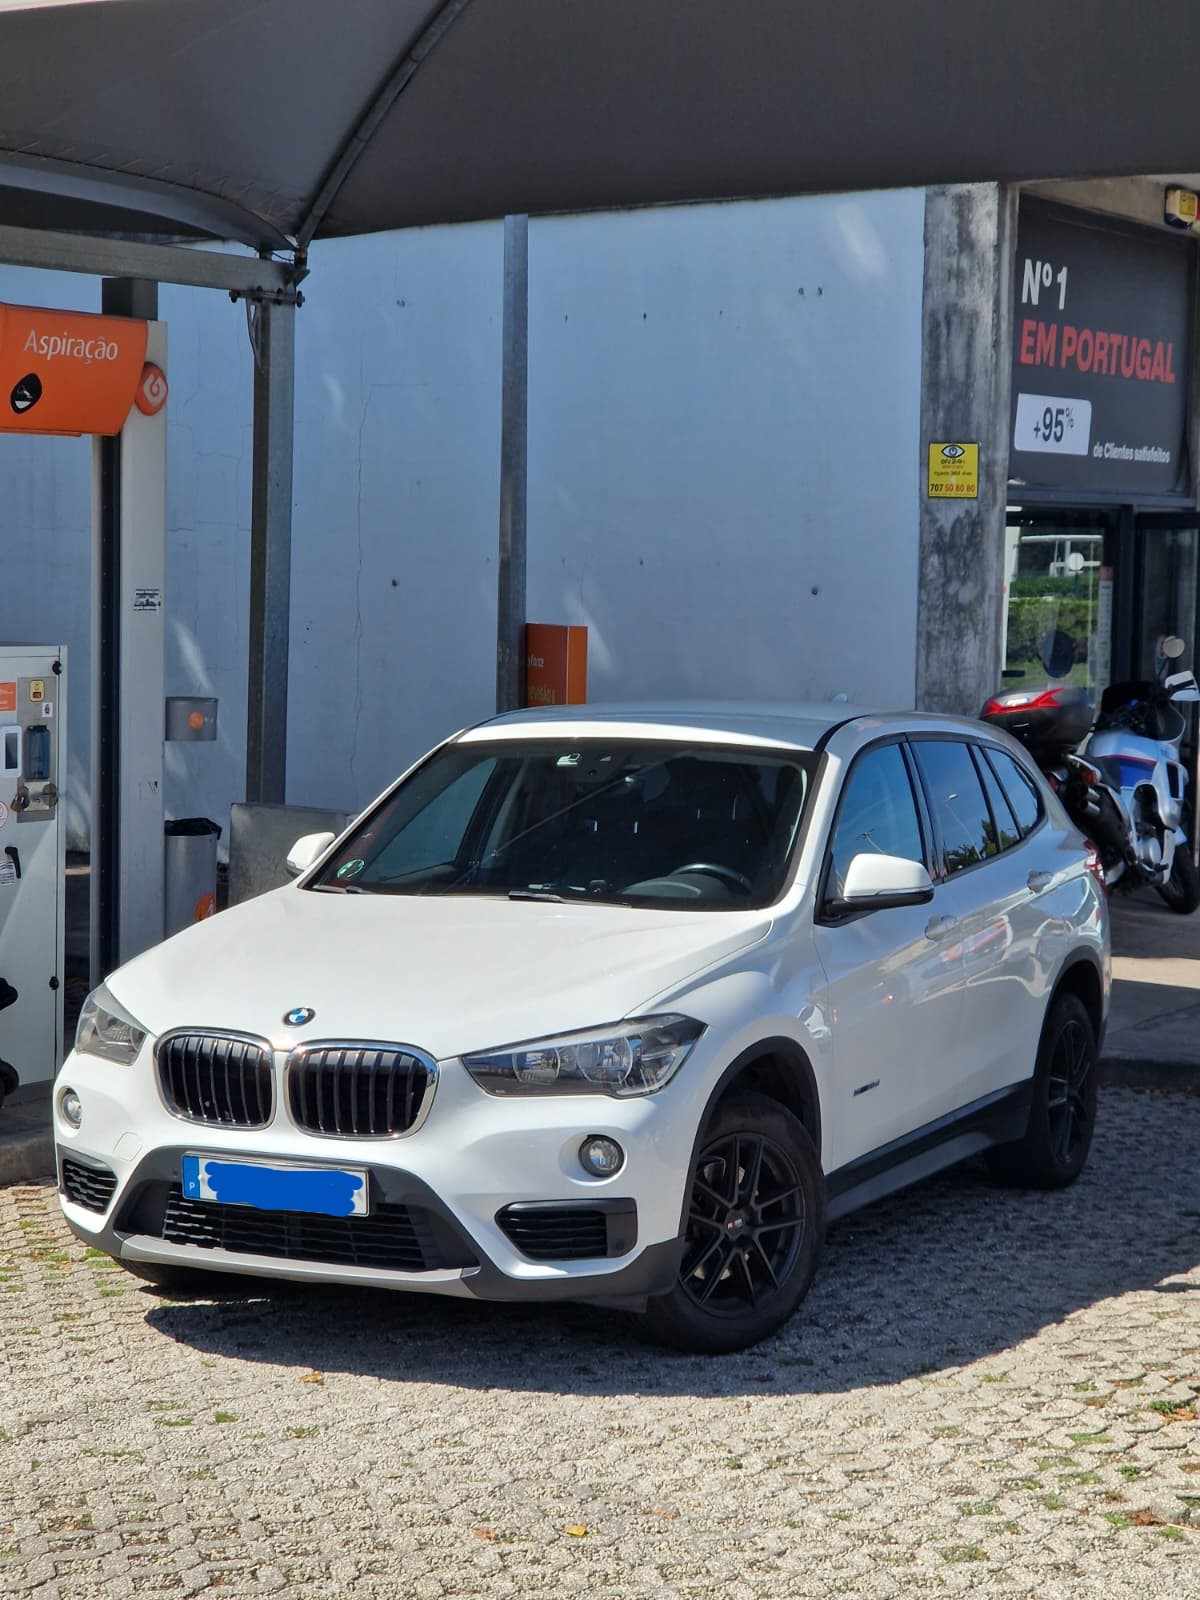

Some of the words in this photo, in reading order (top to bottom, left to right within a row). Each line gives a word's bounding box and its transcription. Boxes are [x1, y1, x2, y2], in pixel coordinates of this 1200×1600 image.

[1056, 266, 1068, 310] 1
[23, 329, 118, 364] Aspiração
[1018, 319, 1057, 367] EM
[1060, 325, 1176, 384] PORTUGAL
[1104, 442, 1134, 461] Clientes
